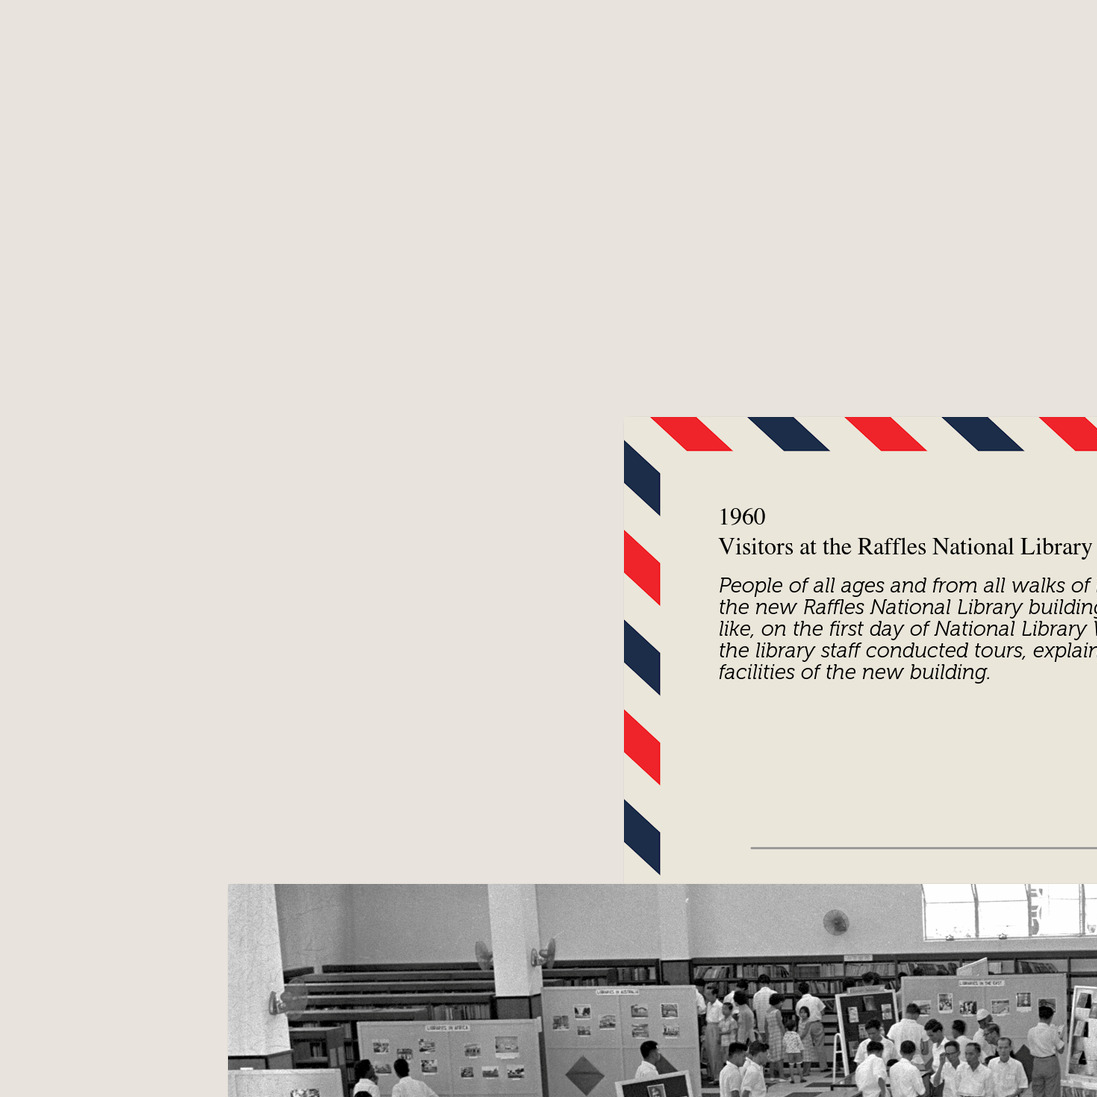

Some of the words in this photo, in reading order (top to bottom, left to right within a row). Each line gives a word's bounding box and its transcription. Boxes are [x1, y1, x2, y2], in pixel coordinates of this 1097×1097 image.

[720, 508, 765, 525] 1960
[719, 538, 793, 555] Visitors
[800, 540, 817, 555] at
[823, 538, 851, 555] the
[858, 538, 926, 555] Raffles
[933, 538, 1013, 555] National
[1021, 538, 1092, 560] Library
[720, 577, 782, 597] People
[789, 577, 809, 593] of
[814, 577, 835, 593] all
[841, 581, 884, 597] ages
[890, 577, 926, 593] and
[933, 577, 977, 593] from
[984, 577, 1005, 593] all
[1012, 577, 1065, 593] walks
[1072, 577, 1092, 593] of
[720, 599, 749, 614] the
[756, 603, 797, 614] new
[804, 599, 864, 614] Raffles
[870, 599, 951, 614] National
[958, 599, 1023, 619] Library
[719, 621, 754, 639] like,
[762, 624, 785, 636] on
[794, 621, 823, 636] the
[830, 621, 864, 636] first
[870, 621, 904, 640] day
[910, 621, 930, 636] of
[934, 621, 1015, 636] National
[1022, 621, 1087, 640] Library
[720, 642, 749, 658] the
[756, 642, 816, 662] library
[821, 642, 862, 658] staff
[866, 642, 968, 658] conducted
[975, 643, 1025, 660] tours,
[719, 664, 795, 679] facilities
[801, 664, 821, 679] of
[827, 664, 856, 679] the
[863, 668, 904, 679] new
[910, 664, 989, 684] building.
